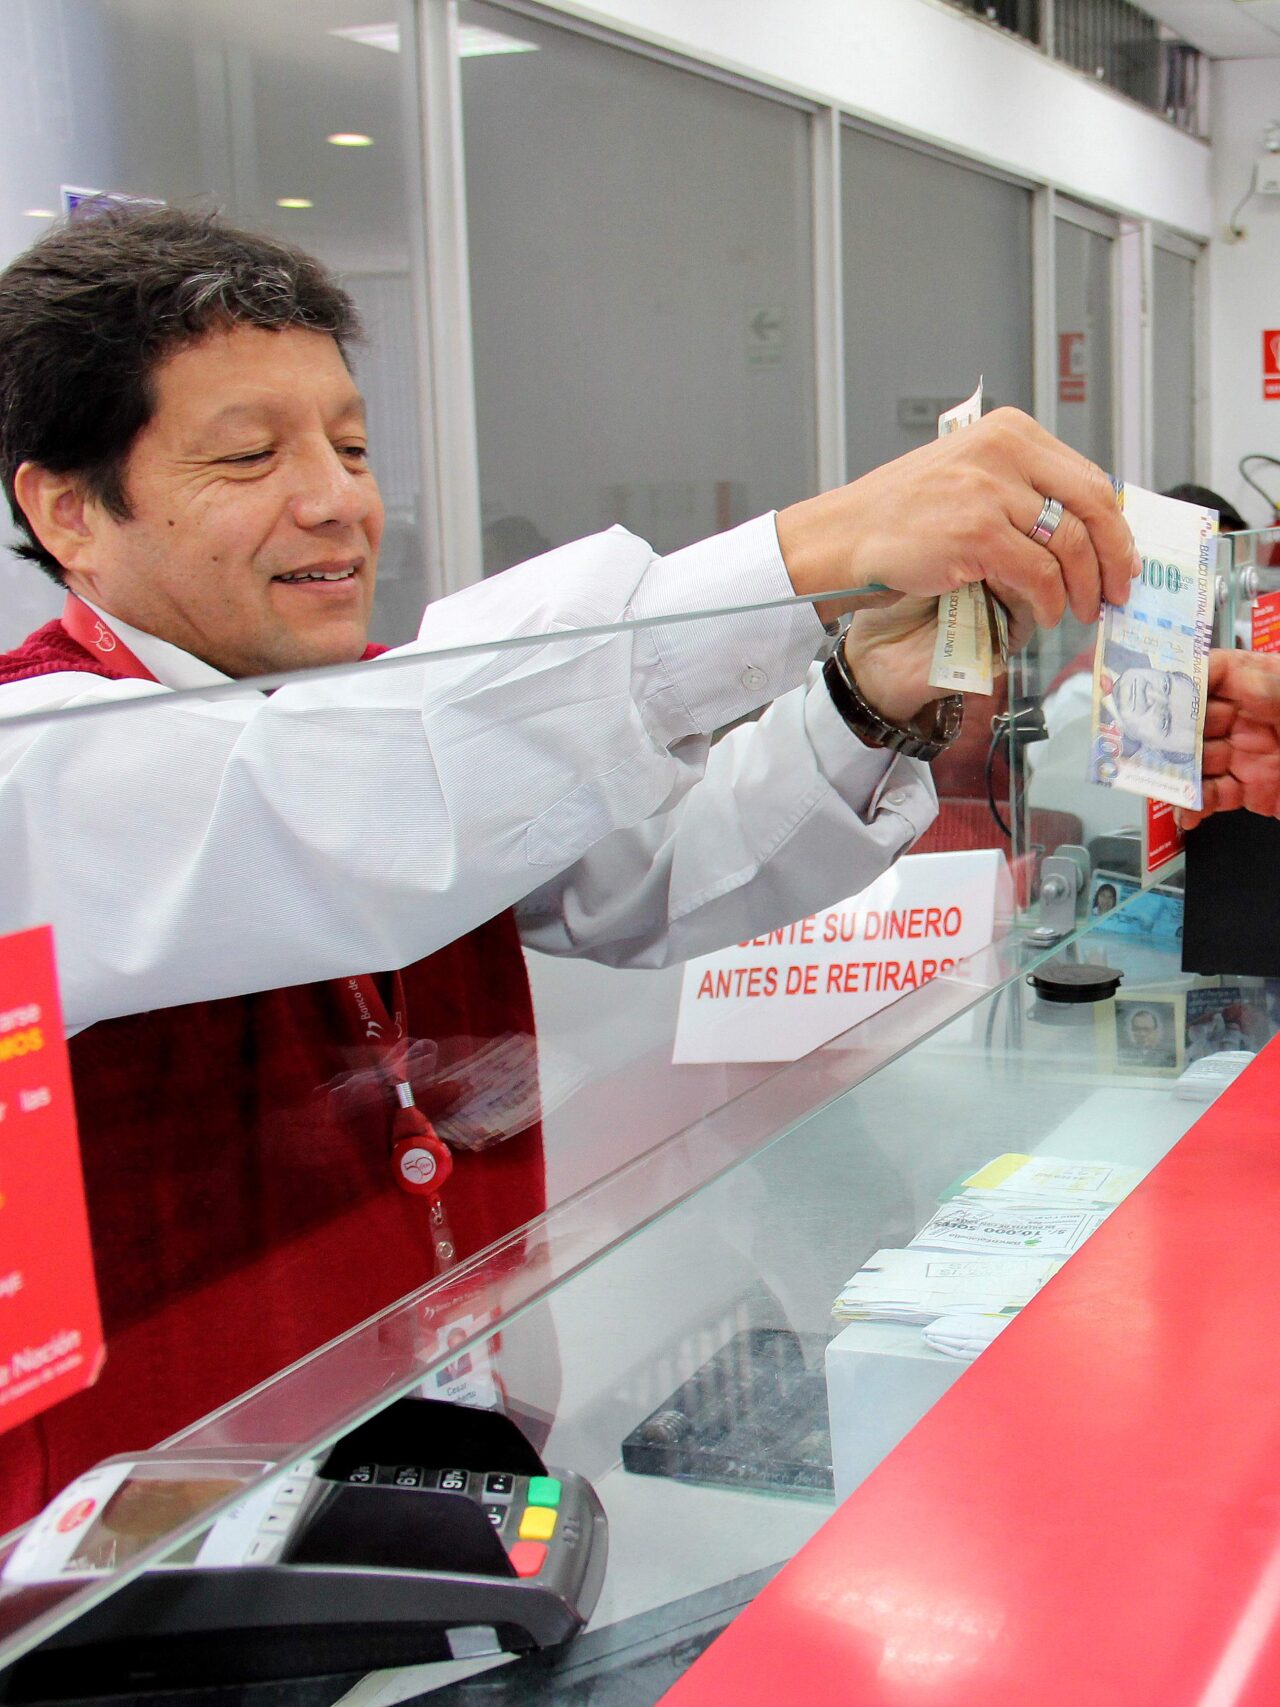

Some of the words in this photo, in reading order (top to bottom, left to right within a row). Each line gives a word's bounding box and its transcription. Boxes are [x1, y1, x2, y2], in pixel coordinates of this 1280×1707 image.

[1198, 544, 1209, 576] BANCO
[1196, 577, 1208, 617] CENTRAL
[948, 595, 959, 629] NUEVOS
[944, 630, 955, 658] VEINTE
[1192, 634, 1204, 674] RESERVA
[823, 912, 856, 943] SU
[863, 905, 962, 942] DINERO
[348, 979, 359, 991] de
[697, 966, 778, 1000] ANTES
[785, 964, 819, 996] DE
[355, 992, 371, 1020] Banco
[983, 1227, 1041, 1237] 10,000
[349, 1473, 370, 1482] 3
[396, 1477, 417, 1486] 6
[442, 1480, 463, 1489] 9
